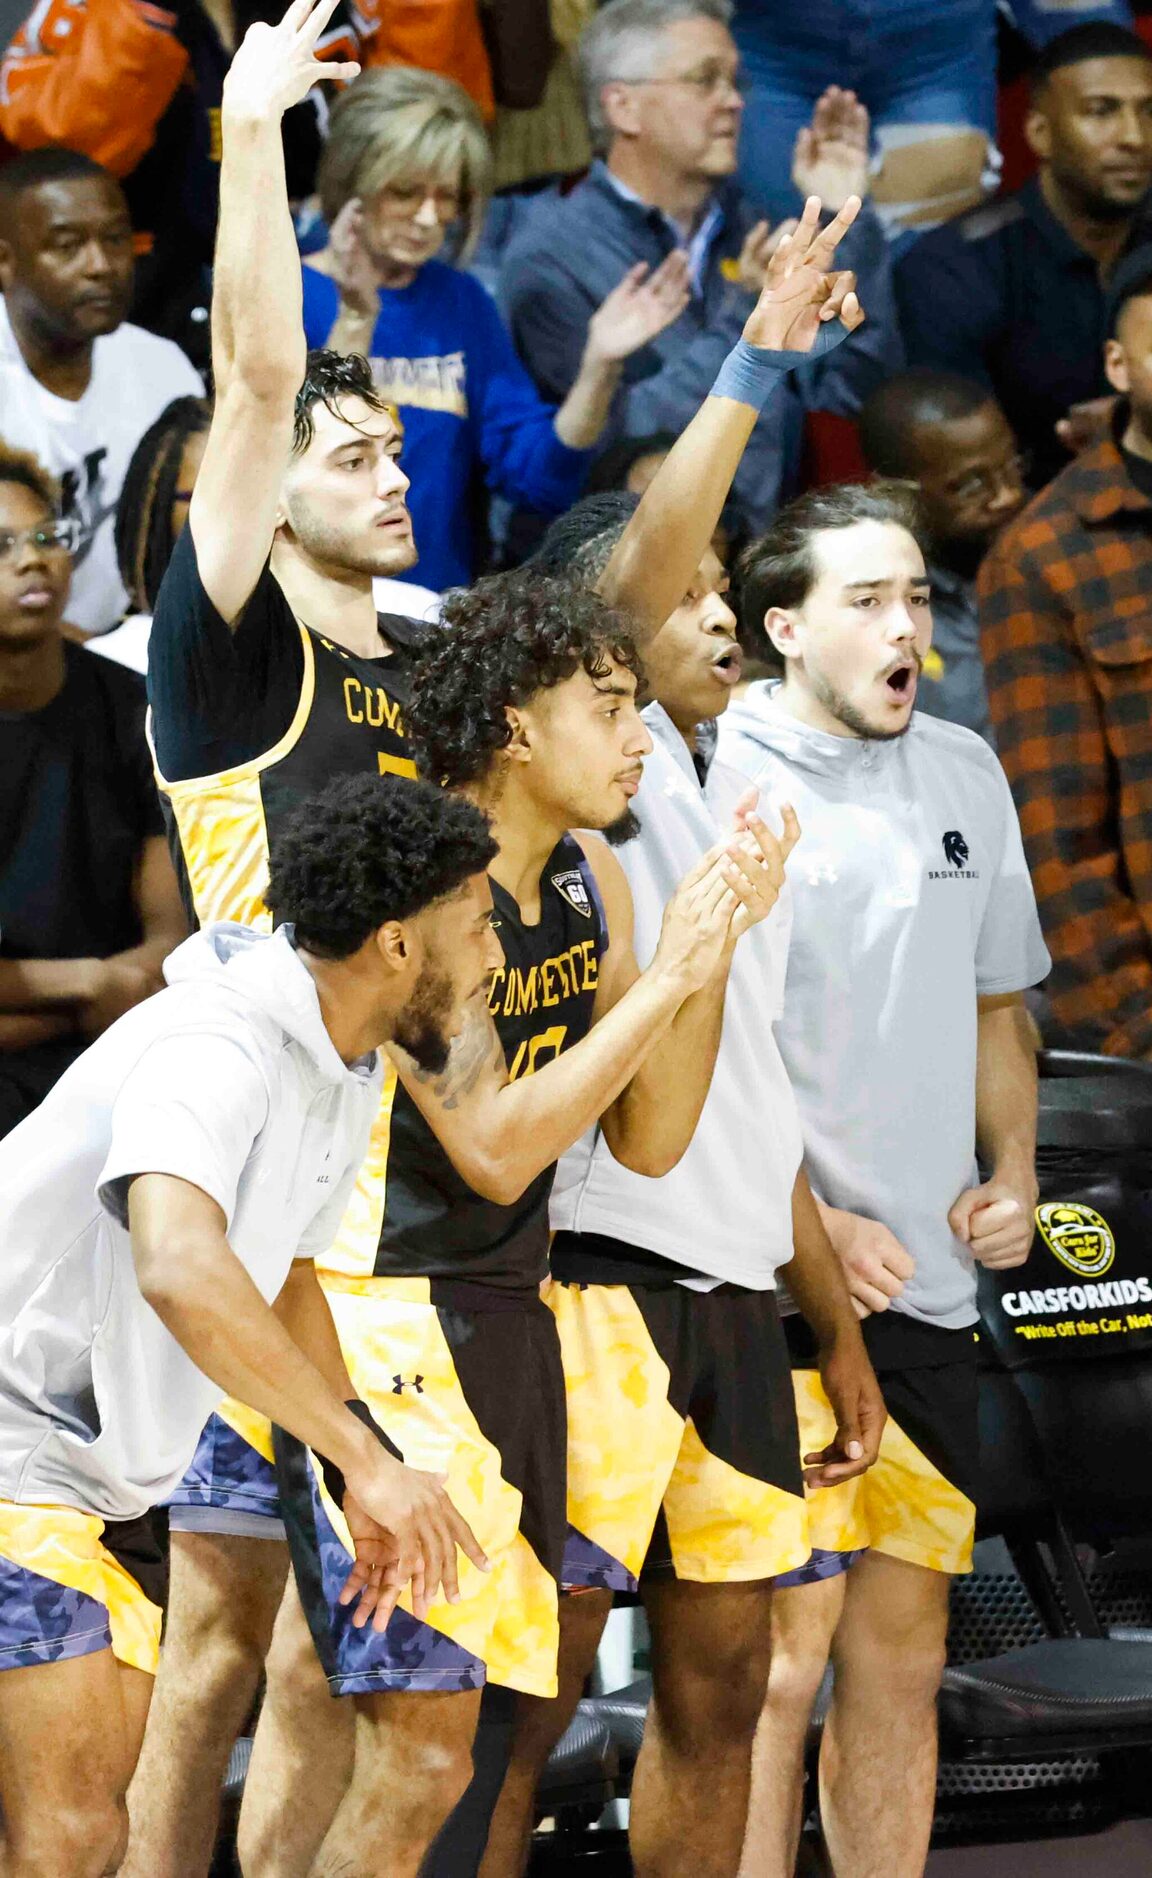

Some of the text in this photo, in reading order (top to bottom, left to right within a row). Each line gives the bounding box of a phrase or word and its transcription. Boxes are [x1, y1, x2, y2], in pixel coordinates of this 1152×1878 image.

[1055, 1320, 1076, 1337] Off
[1077, 1319, 1100, 1336] the
[1099, 1317, 1128, 1333] Car,
[1126, 1313, 1152, 1330] Not
